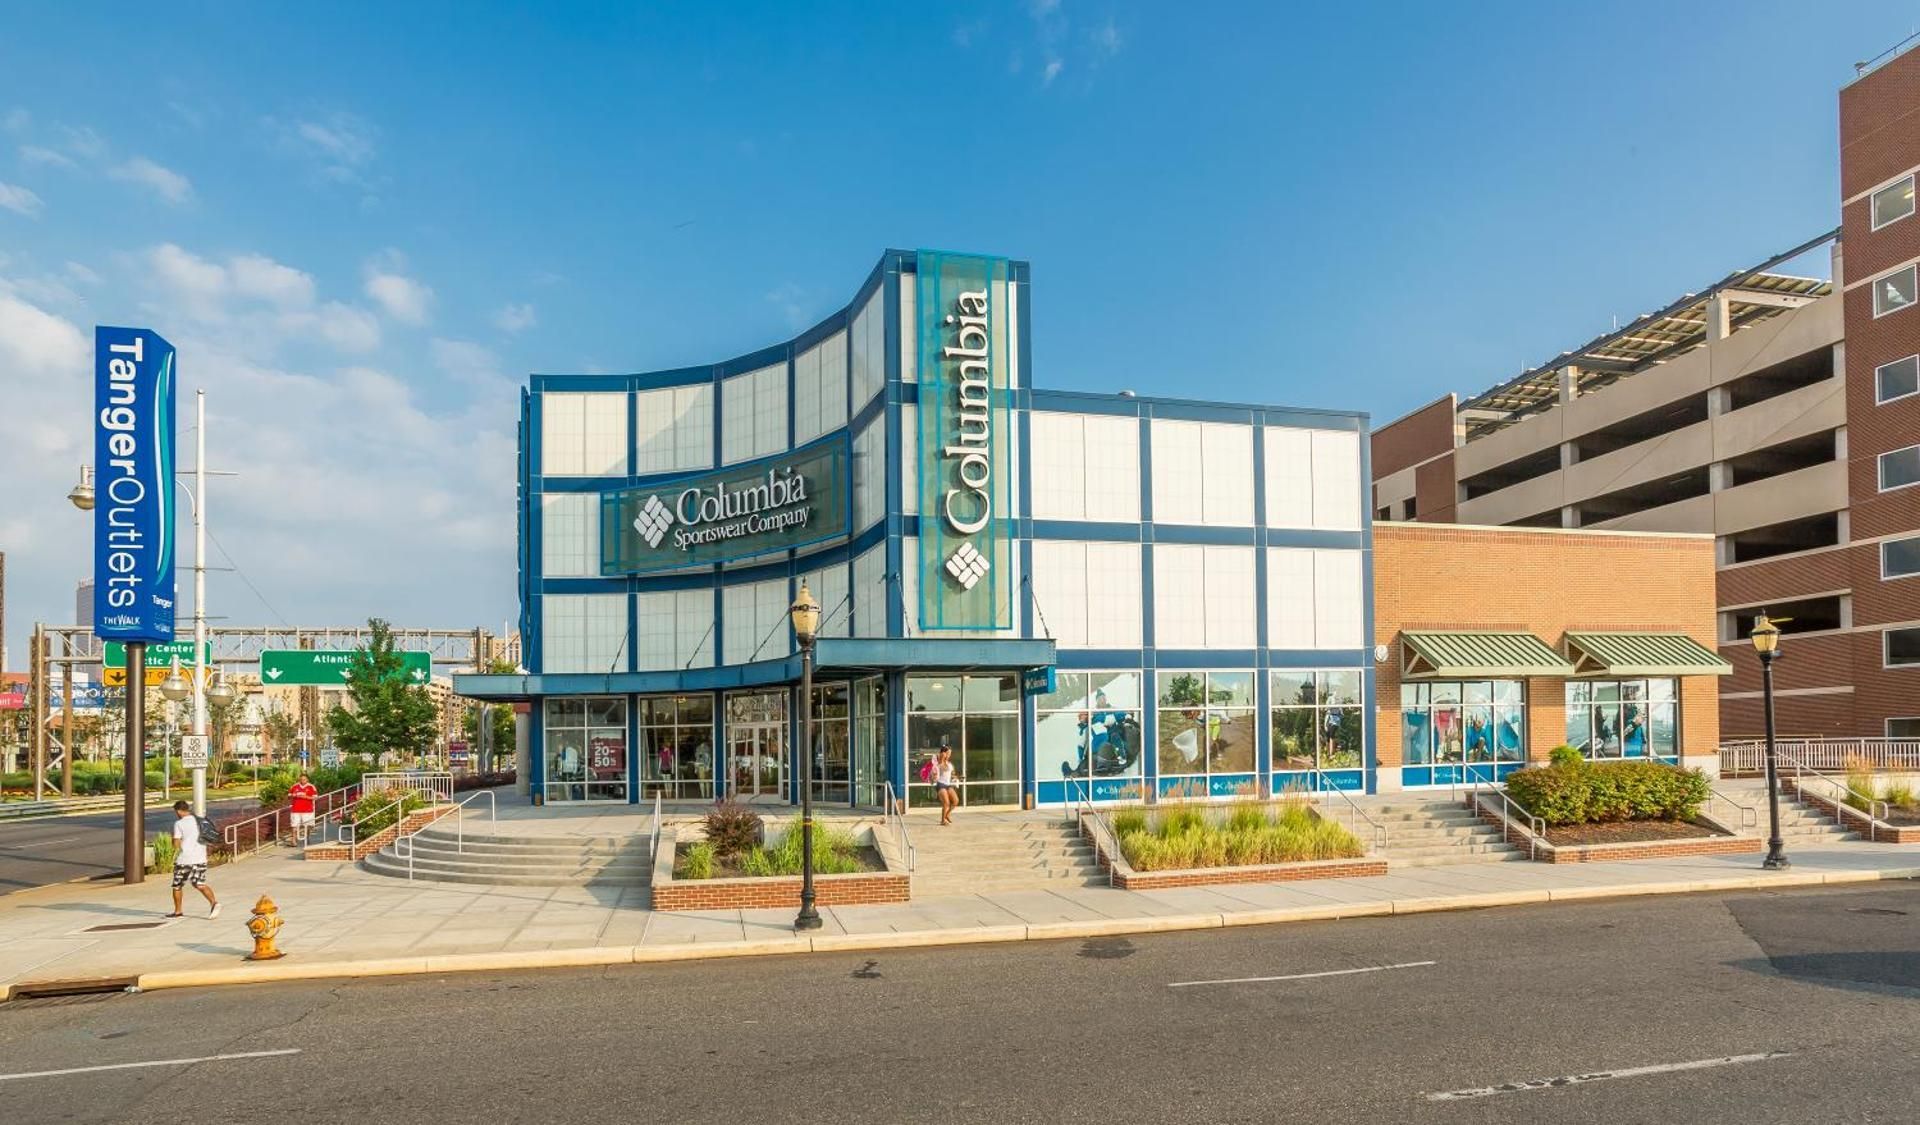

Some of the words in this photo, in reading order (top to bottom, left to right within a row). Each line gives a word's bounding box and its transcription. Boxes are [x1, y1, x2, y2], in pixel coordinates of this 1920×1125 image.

[944, 288, 990, 535] Columbia
[676, 467, 807, 526] Columbia
[674, 521, 748, 550] Sportswear
[747, 506, 810, 534] Company
[155, 644, 194, 653] Center
[313, 654, 355, 663] Atlanti
